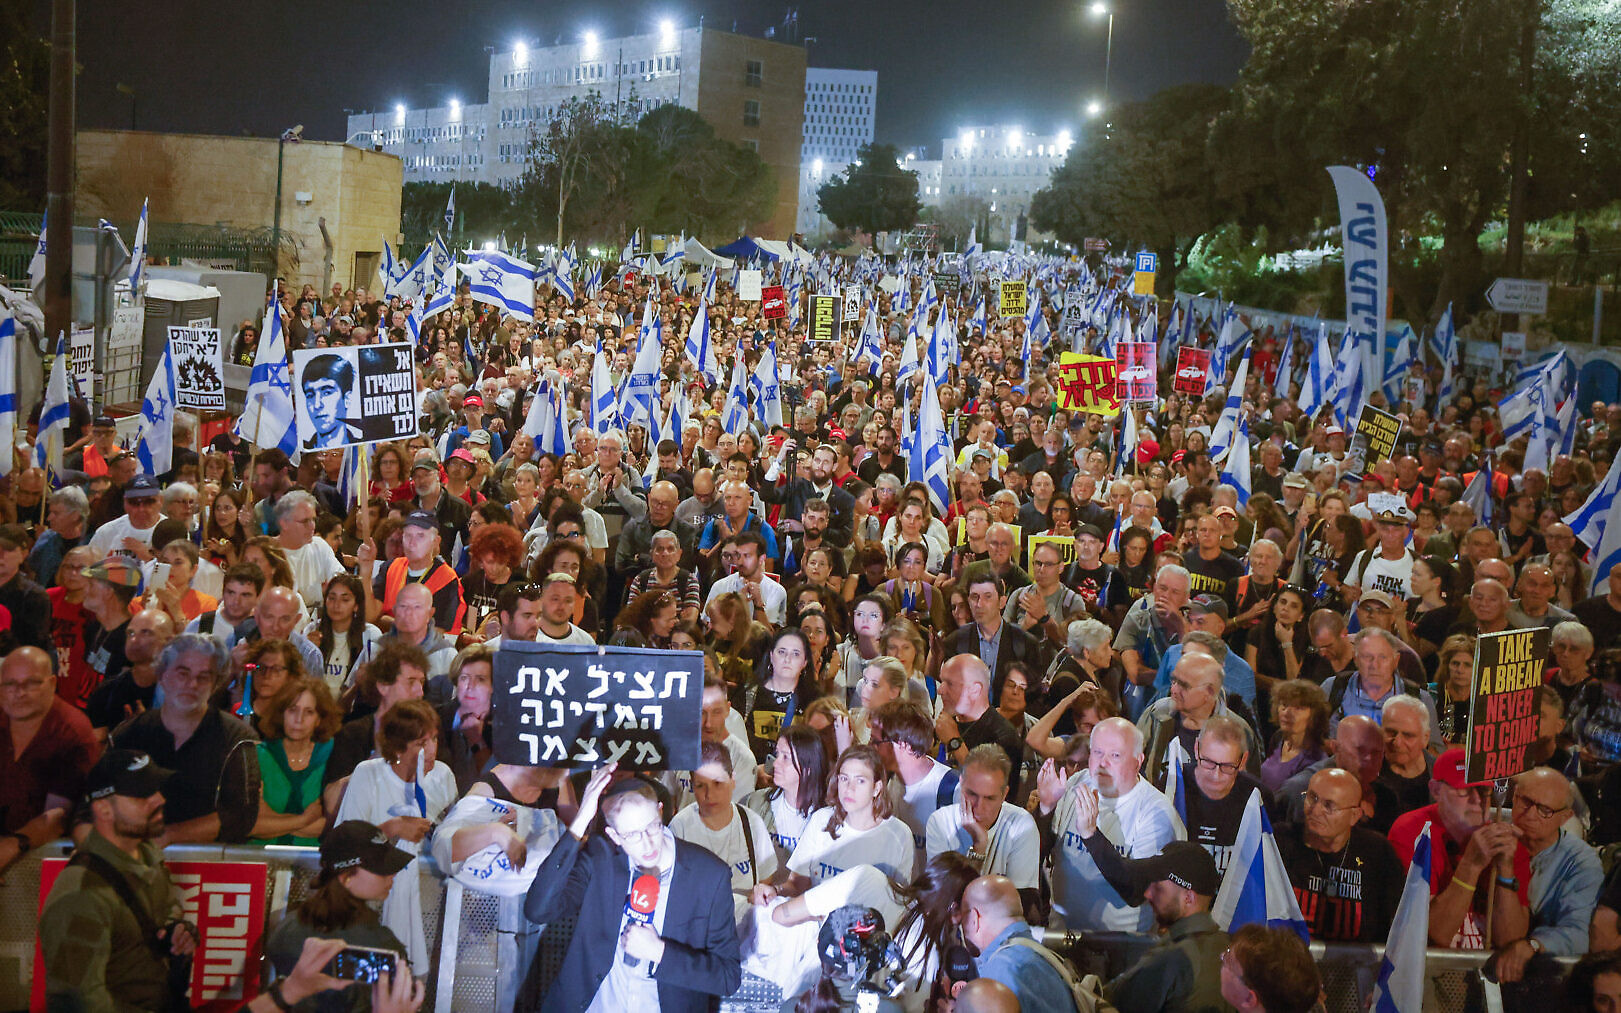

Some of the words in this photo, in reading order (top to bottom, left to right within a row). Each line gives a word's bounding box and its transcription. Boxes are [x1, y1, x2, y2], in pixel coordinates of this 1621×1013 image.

[171, 329, 200, 342] שהרס
[201, 330, 218, 342] מי
[196, 343, 218, 356] לא
[394, 349, 411, 371] אל
[364, 371, 412, 395] תשאירו
[363, 394, 396, 417] אותם
[398, 392, 414, 413] גם
[392, 411, 414, 434] לבד
[1498, 632, 1535, 665] TAKE
[509, 665, 570, 696] את
[587, 664, 692, 699] תציל
[1479, 666, 1492, 696] A
[1494, 658, 1545, 695] BREAK
[520, 698, 663, 730] המדינה
[1486, 688, 1534, 724] NEVER
[1474, 723, 1496, 754] TO
[1498, 714, 1540, 751] COME
[518, 732, 662, 765] מעצמך
[1483, 745, 1527, 780] BACK
[333, 857, 361, 870] POLICE
[1168, 872, 1193, 890] משטרה
[1339, 882, 1362, 901] אותם
[633, 889, 649, 908] 14
[201, 882, 252, 1000] החורבן
